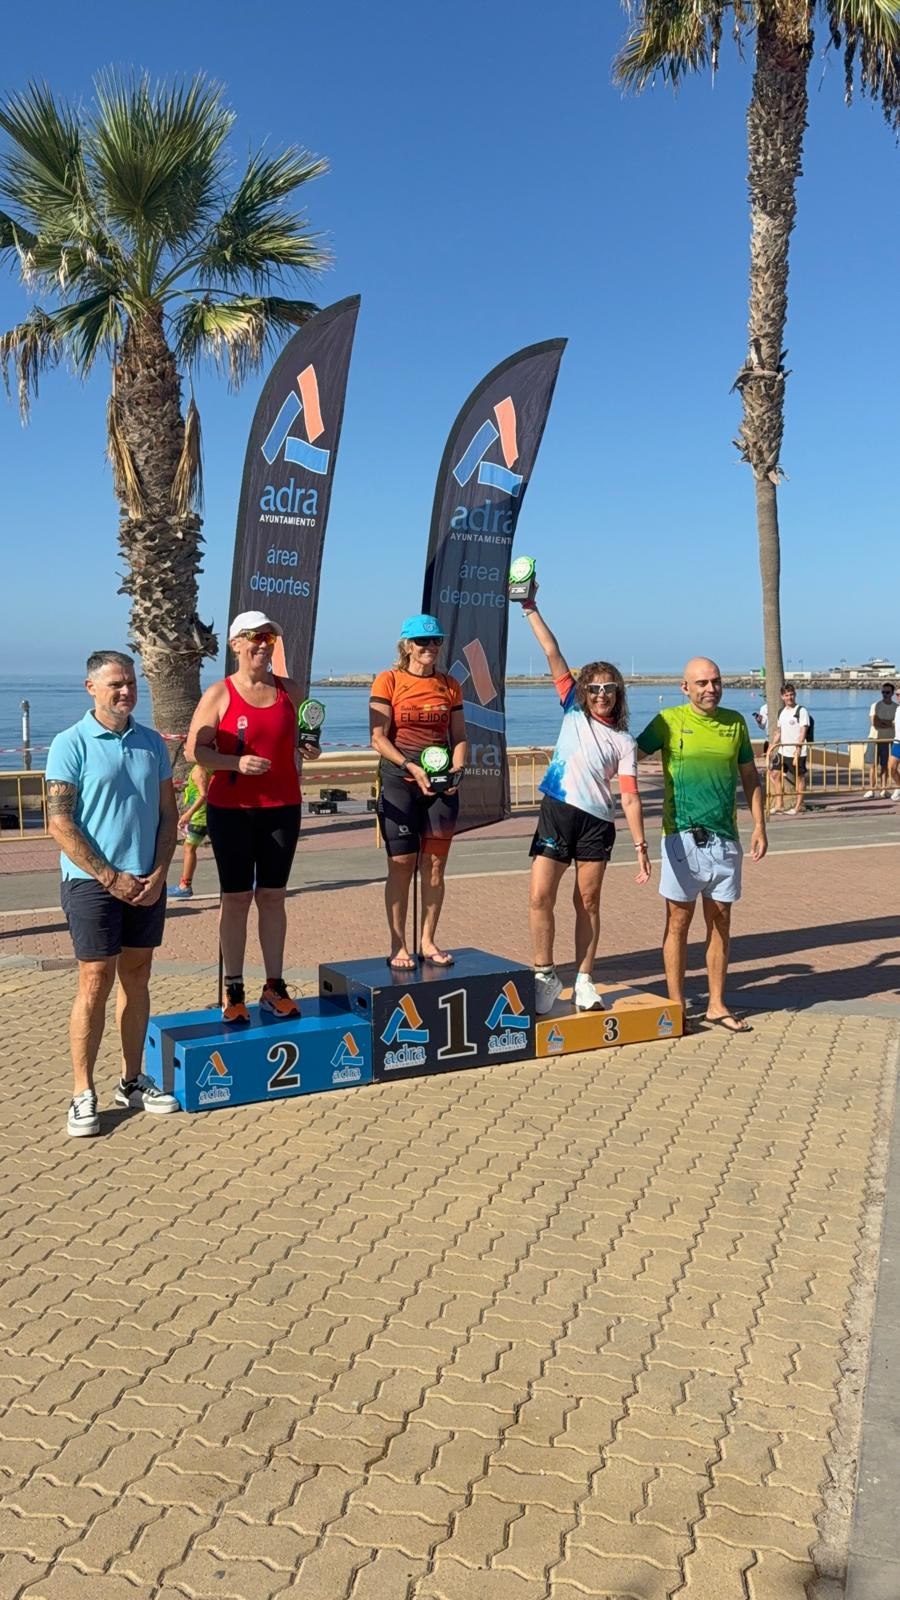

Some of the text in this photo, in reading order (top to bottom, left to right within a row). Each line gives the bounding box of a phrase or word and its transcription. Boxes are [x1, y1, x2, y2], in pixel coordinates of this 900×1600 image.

[259, 477, 318, 516] adra
[259, 513, 316, 528] AYUNTAMIENTO
[450, 498, 513, 535] adra
[450, 531, 512, 545] AYUNTAMIENT
[266, 543, 298, 567] área
[460, 559, 500, 582] área
[249, 570, 311, 598] deportes
[440, 584, 506, 609] deporte
[400, 712, 449, 723] EL EJIDO
[437, 988, 478, 1060] 1
[603, 1016, 620, 1043] 3
[488, 1029, 528, 1048] adra
[383, 1043, 427, 1065] adra
[266, 1041, 300, 1092] 2
[332, 1066, 361, 1081] adra
[199, 1086, 231, 1102] adra
